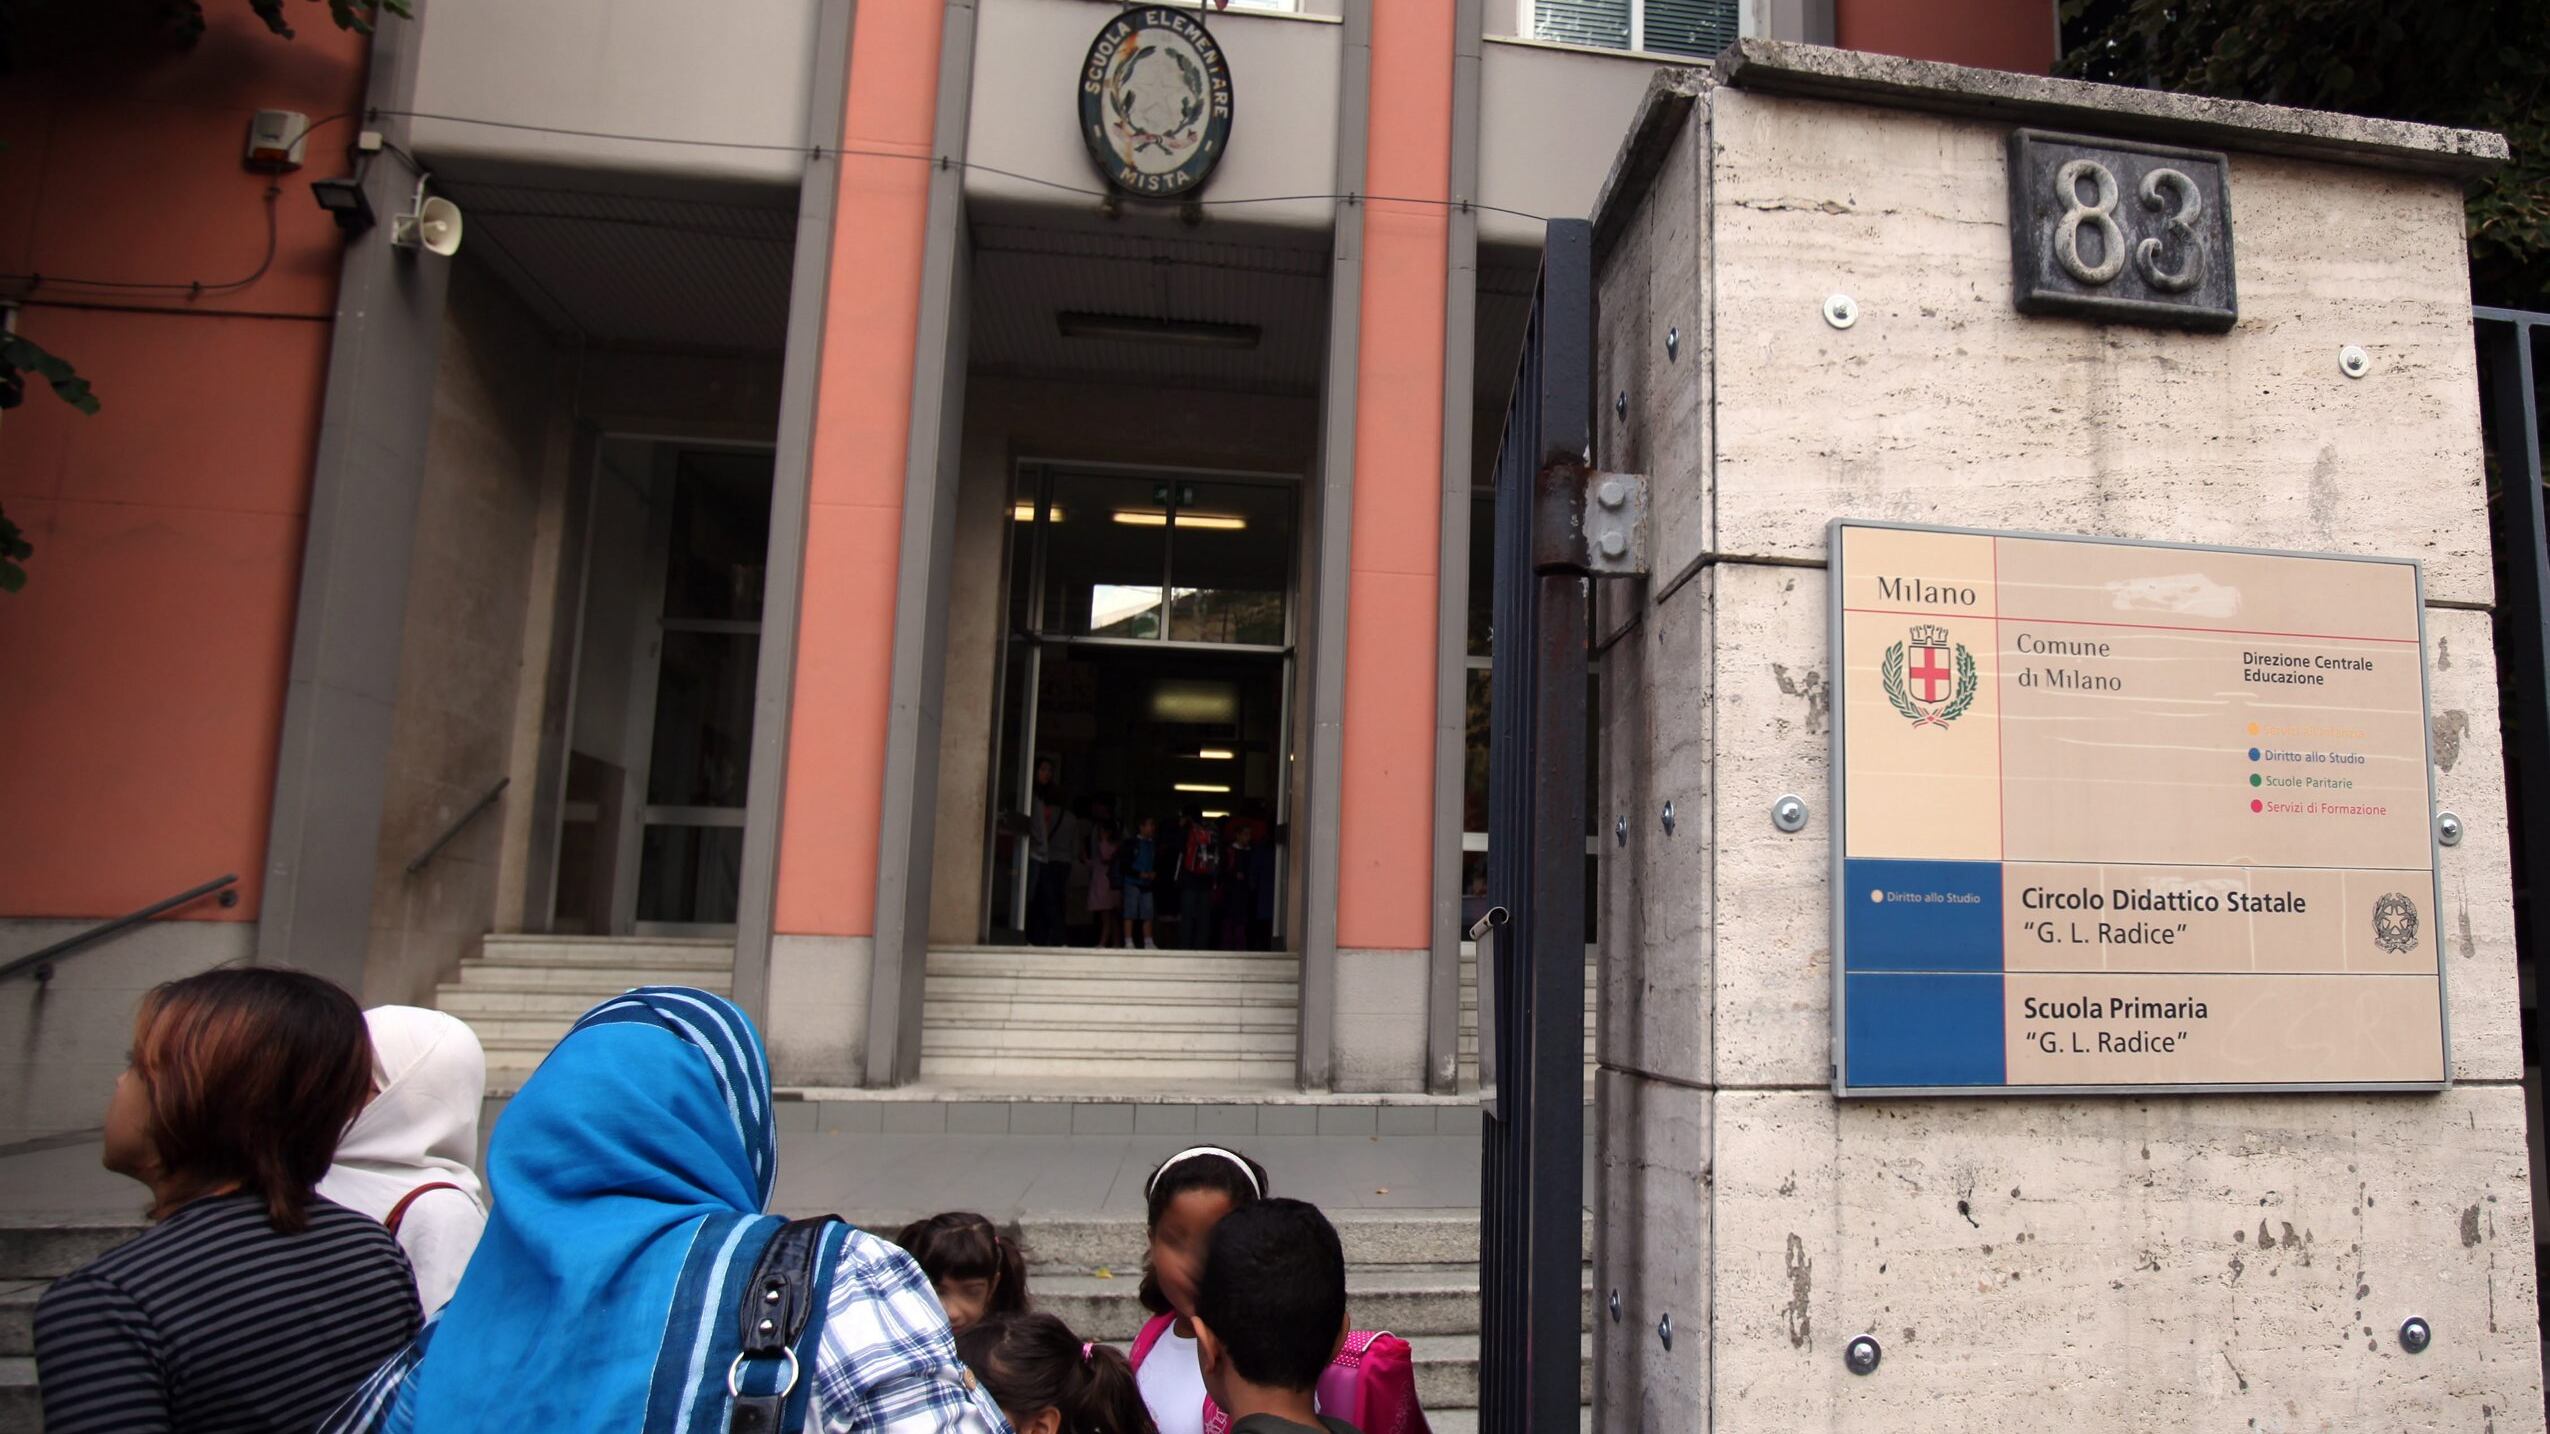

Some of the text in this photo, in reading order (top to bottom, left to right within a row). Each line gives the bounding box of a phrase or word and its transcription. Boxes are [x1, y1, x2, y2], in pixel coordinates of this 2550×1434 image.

[1085, 21, 1131, 95] SCUOLA
[1120, 169, 1190, 191] MISTA
[2055, 159, 2206, 292] 83
[1878, 576, 1976, 606] Milano
[2016, 633, 2110, 657] Comune
[2243, 651, 2373, 672] Direzione Centrale
[2018, 667, 2122, 691] di Milano
[2244, 668, 2324, 686] Educazione
[2265, 749, 2365, 765] Diritto allo Studio
[2265, 775, 2353, 790] Scuole Paritarie
[2267, 801, 2387, 816] Servizi di Formazione
[1887, 891, 1981, 905] Diritto allo Studio
[2022, 886, 2306, 914] Circolo Didattico Statale
[2071, 922, 2089, 944] L.
[2024, 996, 2208, 1019] Scuola Primaria
[2072, 1031, 2090, 1053] L.
